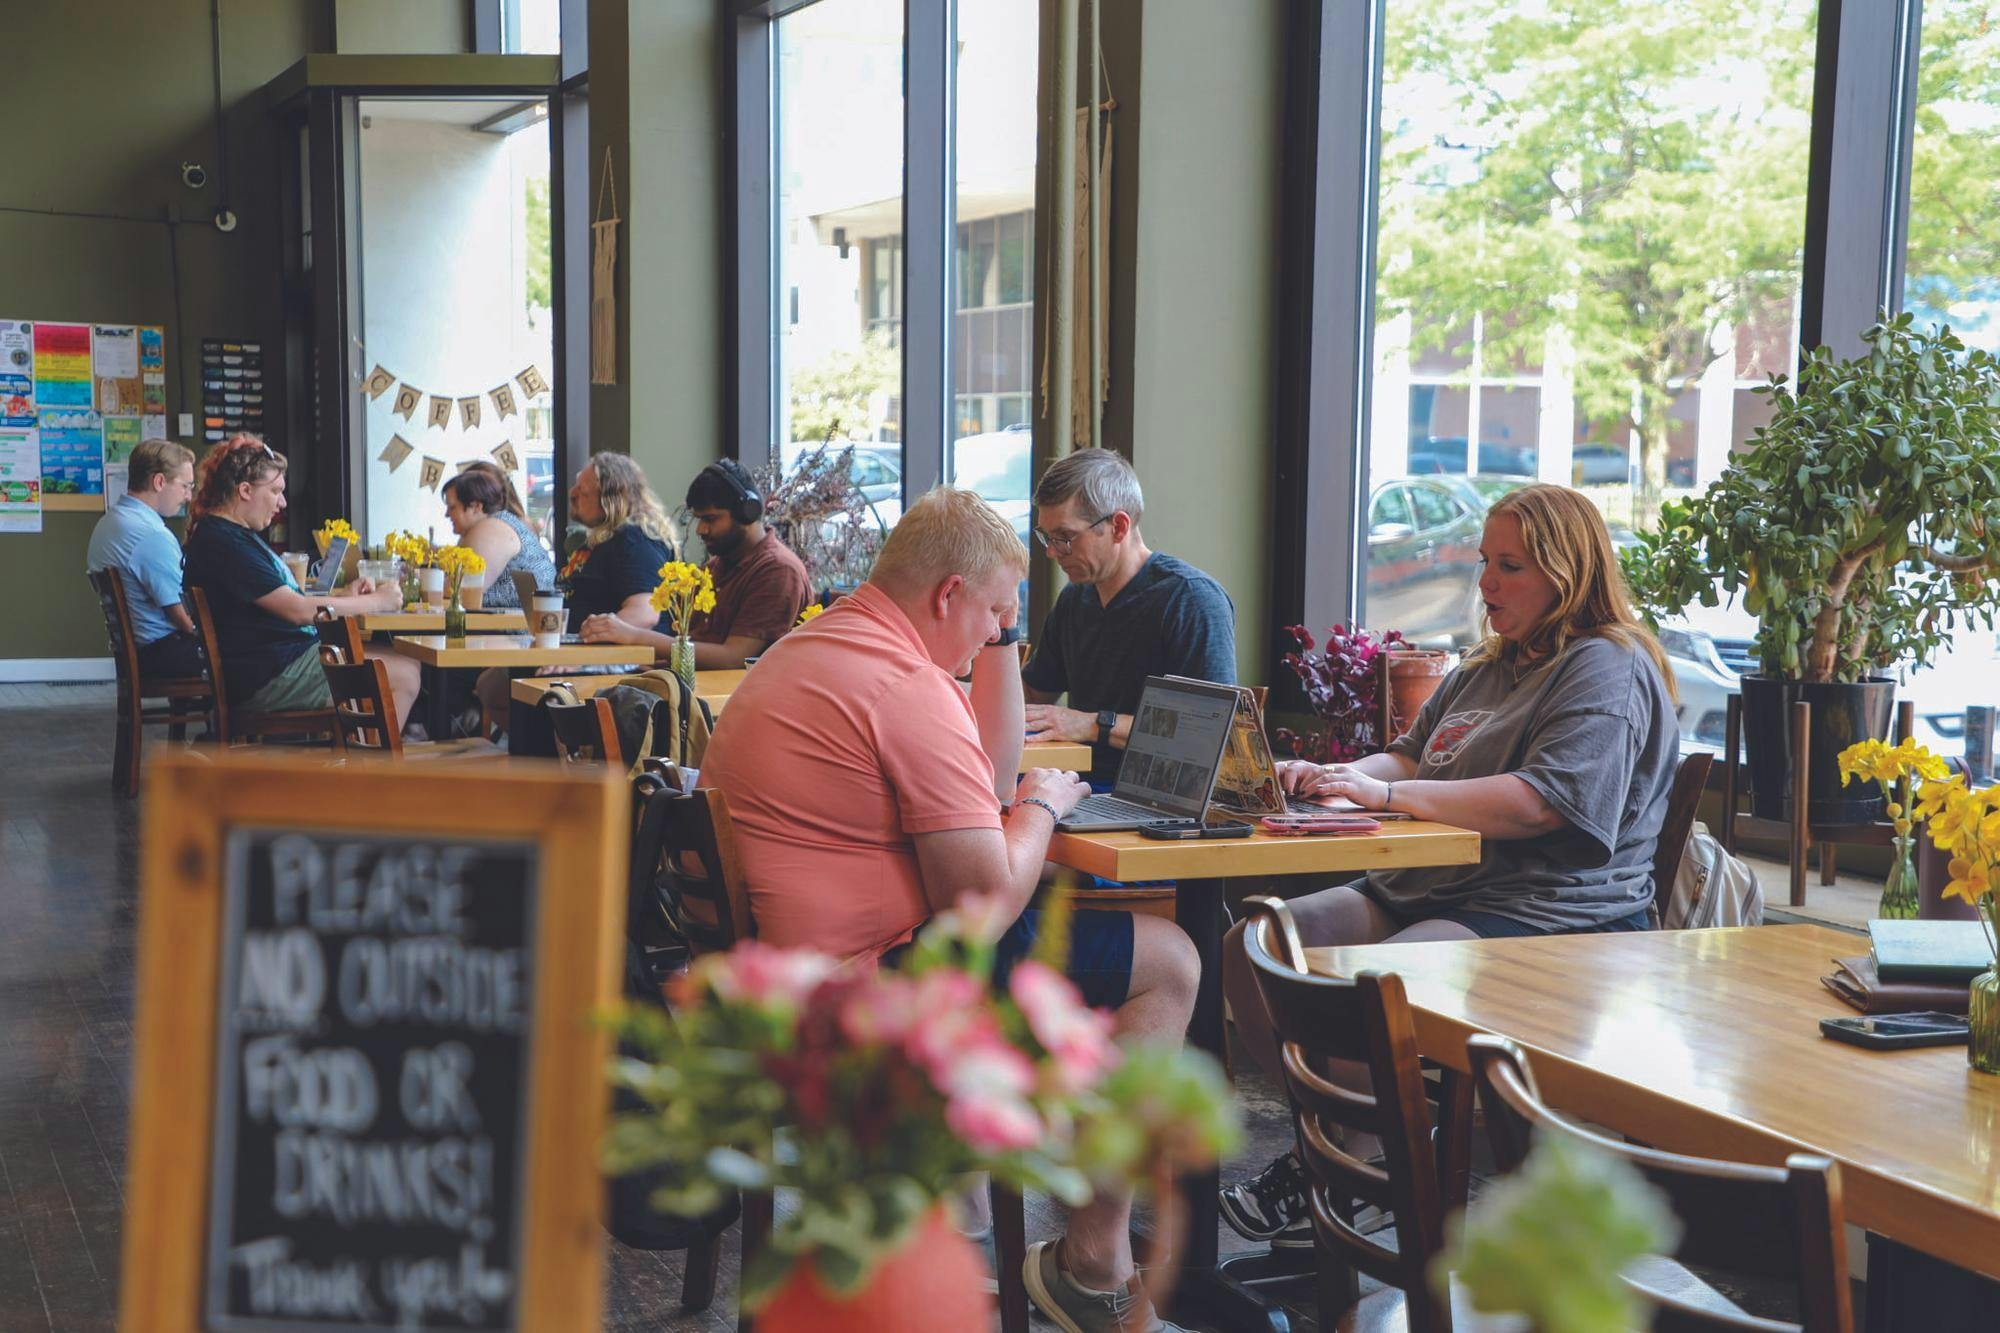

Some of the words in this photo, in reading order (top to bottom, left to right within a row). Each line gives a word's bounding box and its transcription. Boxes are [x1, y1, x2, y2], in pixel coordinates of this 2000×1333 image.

[368, 371, 544, 424] COFFEE
[424, 451, 514, 485] BR
[270, 834, 478, 933] PLEASE
[240, 930, 325, 1022] NO
[338, 934, 529, 1030] OUTSIDE
[244, 1033, 377, 1131] FOOD
[400, 1040, 479, 1131] OR
[274, 1128, 493, 1240] DRINKS!
[231, 1236, 370, 1319] Thank
